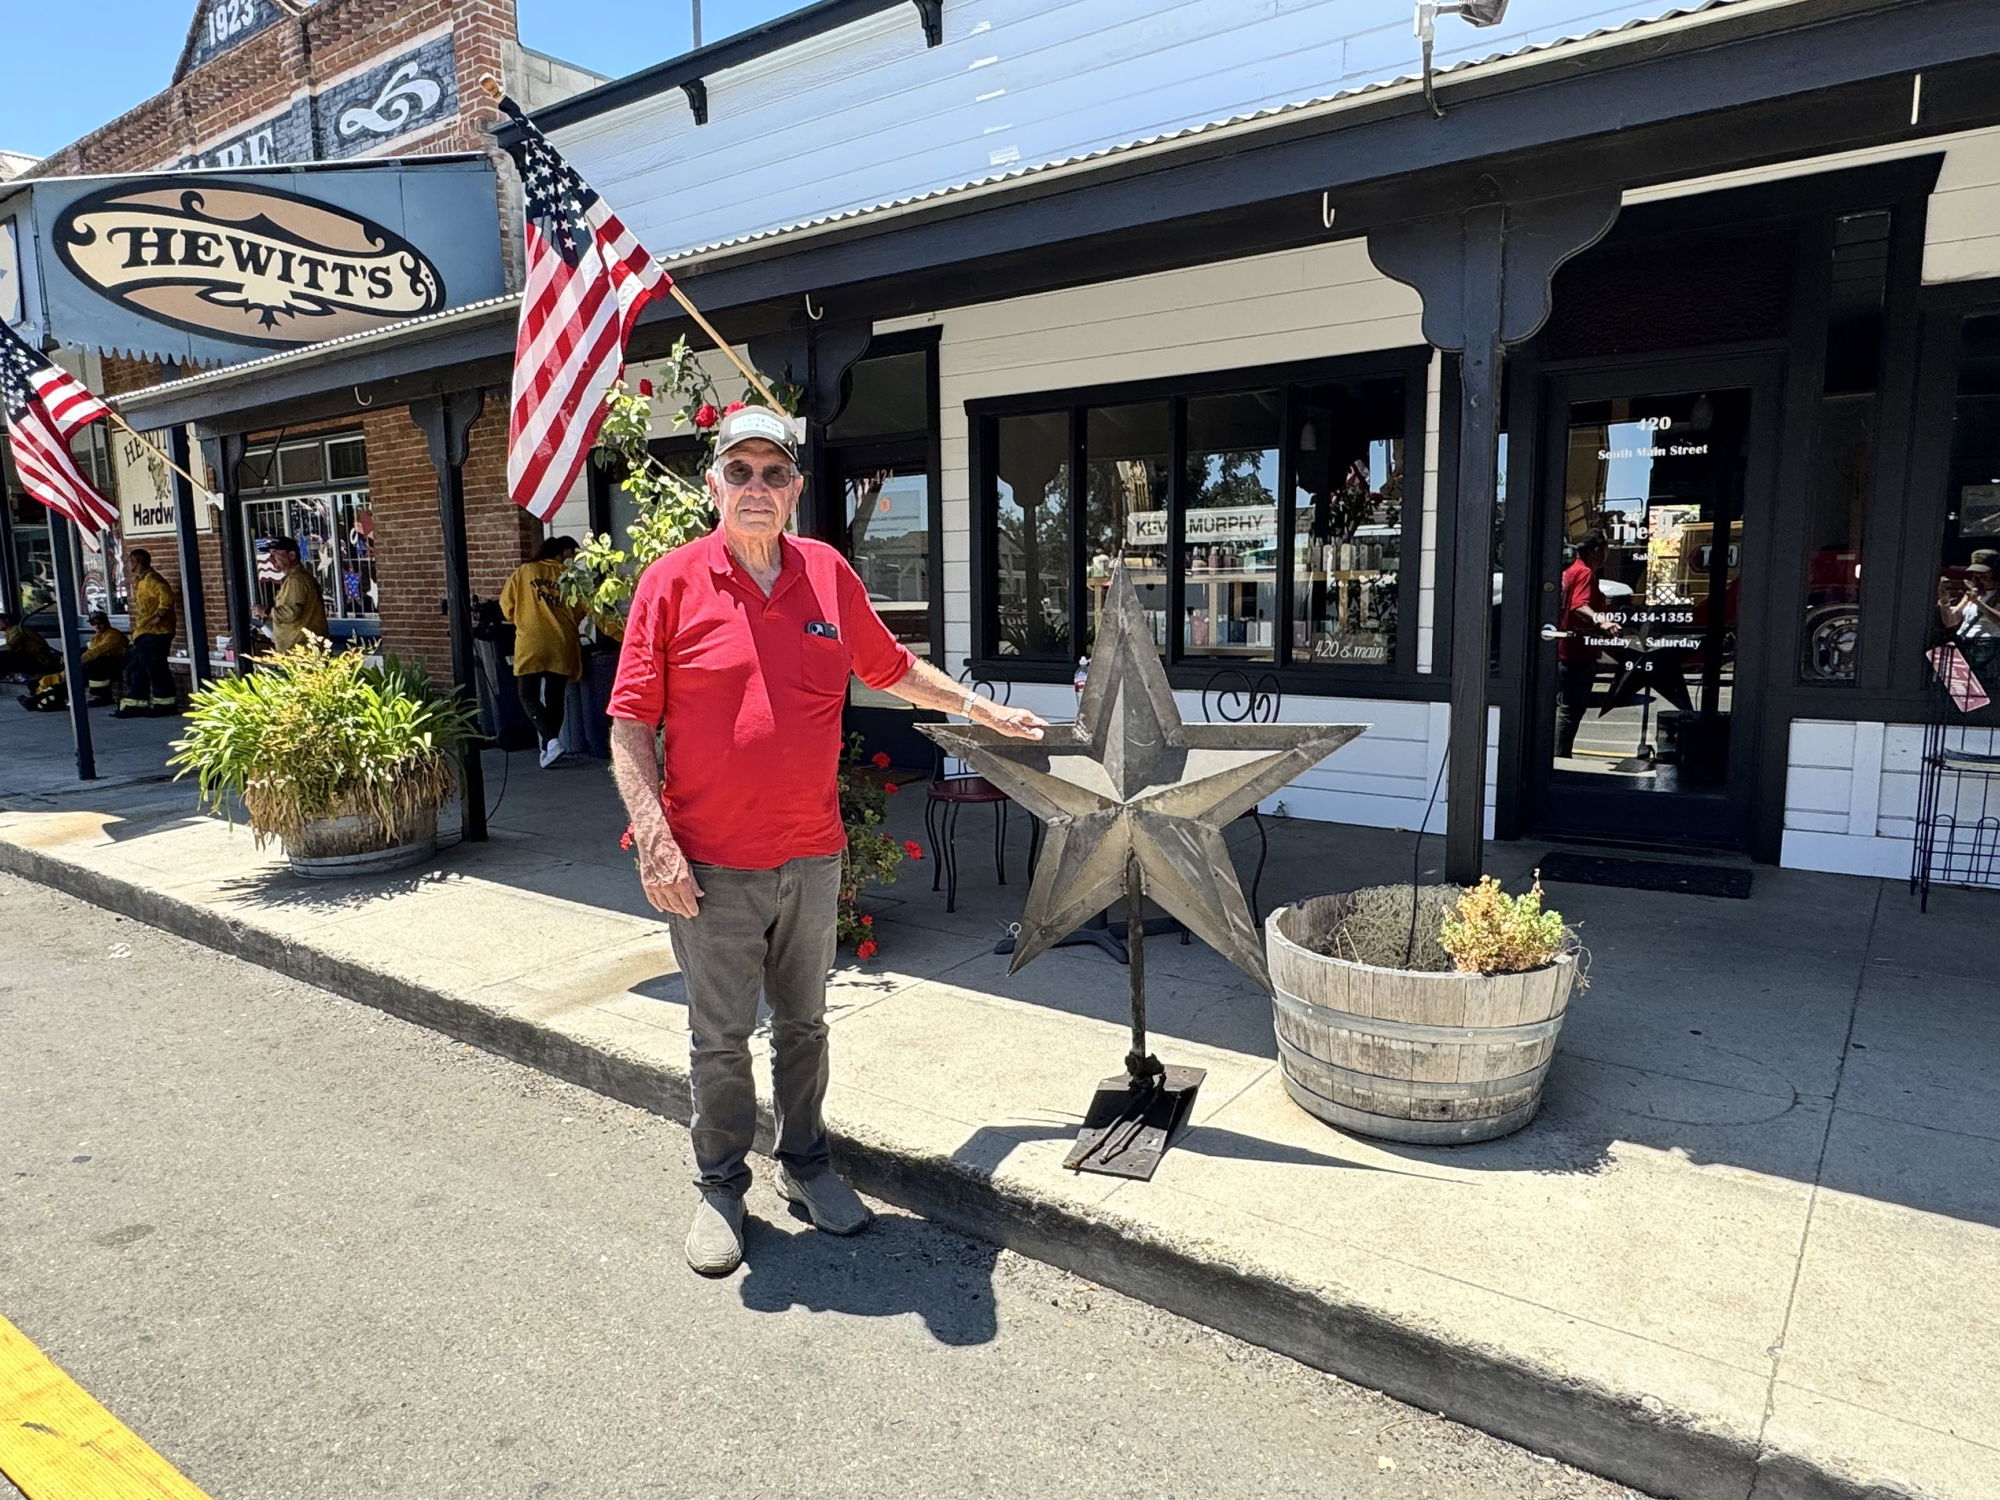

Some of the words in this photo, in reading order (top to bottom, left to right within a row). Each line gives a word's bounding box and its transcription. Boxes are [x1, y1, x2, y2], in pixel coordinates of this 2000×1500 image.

[208, 0, 254, 46] 1923
[106, 226, 393, 299] HEWITT'S
[1637, 416, 1672, 431] 420
[1598, 449, 1632, 460] South
[1637, 446, 1666, 457] Main
[1670, 444, 1708, 456] Street
[873, 468, 894, 484] 424
[1136, 514, 1264, 537] KEV.MURPHY
[1611, 522, 1648, 540] The
[1631, 612, 1693, 623] 434-1355
[1315, 640, 1339, 658] 420
[1353, 643, 1384, 658] main
[1584, 636, 1632, 648] Tuesday
[1646, 637, 1701, 649] Saturday
[1625, 661, 1634, 671] 9
[1645, 662, 1653, 671] 5
